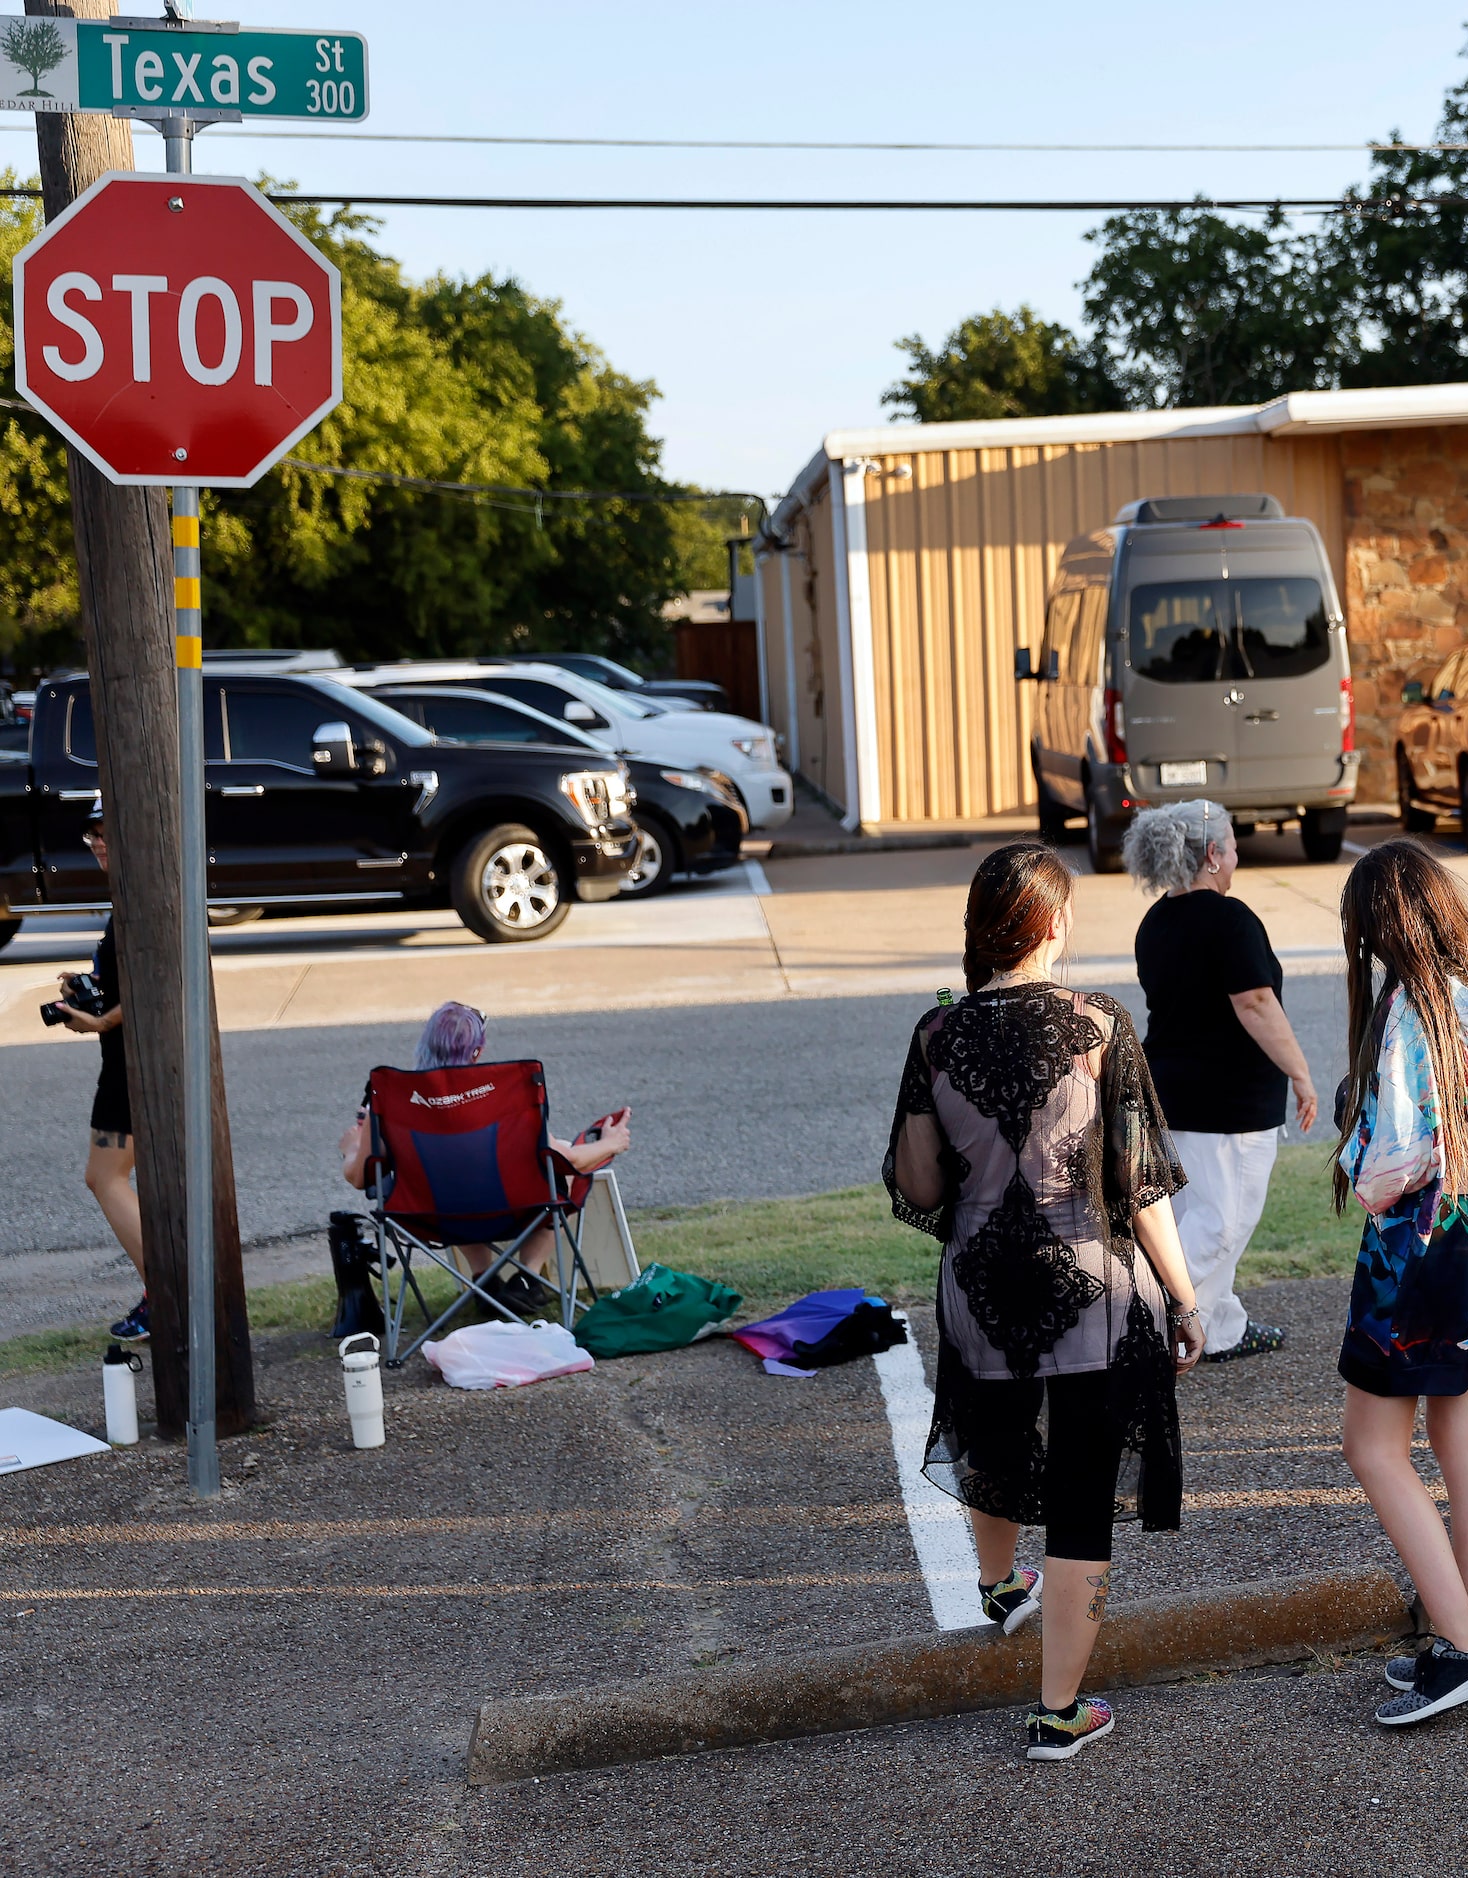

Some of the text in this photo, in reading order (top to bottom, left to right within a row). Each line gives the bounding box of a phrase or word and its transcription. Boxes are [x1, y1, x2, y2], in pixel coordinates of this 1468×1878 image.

[102, 33, 277, 106] Texas
[314, 38, 345, 73] St
[42, 100, 77, 112] HILL
[305, 79, 356, 115] 300
[42, 271, 315, 387] STOP
[427, 1092, 465, 1106] OZARK
[464, 1082, 496, 1099] TRAIL
